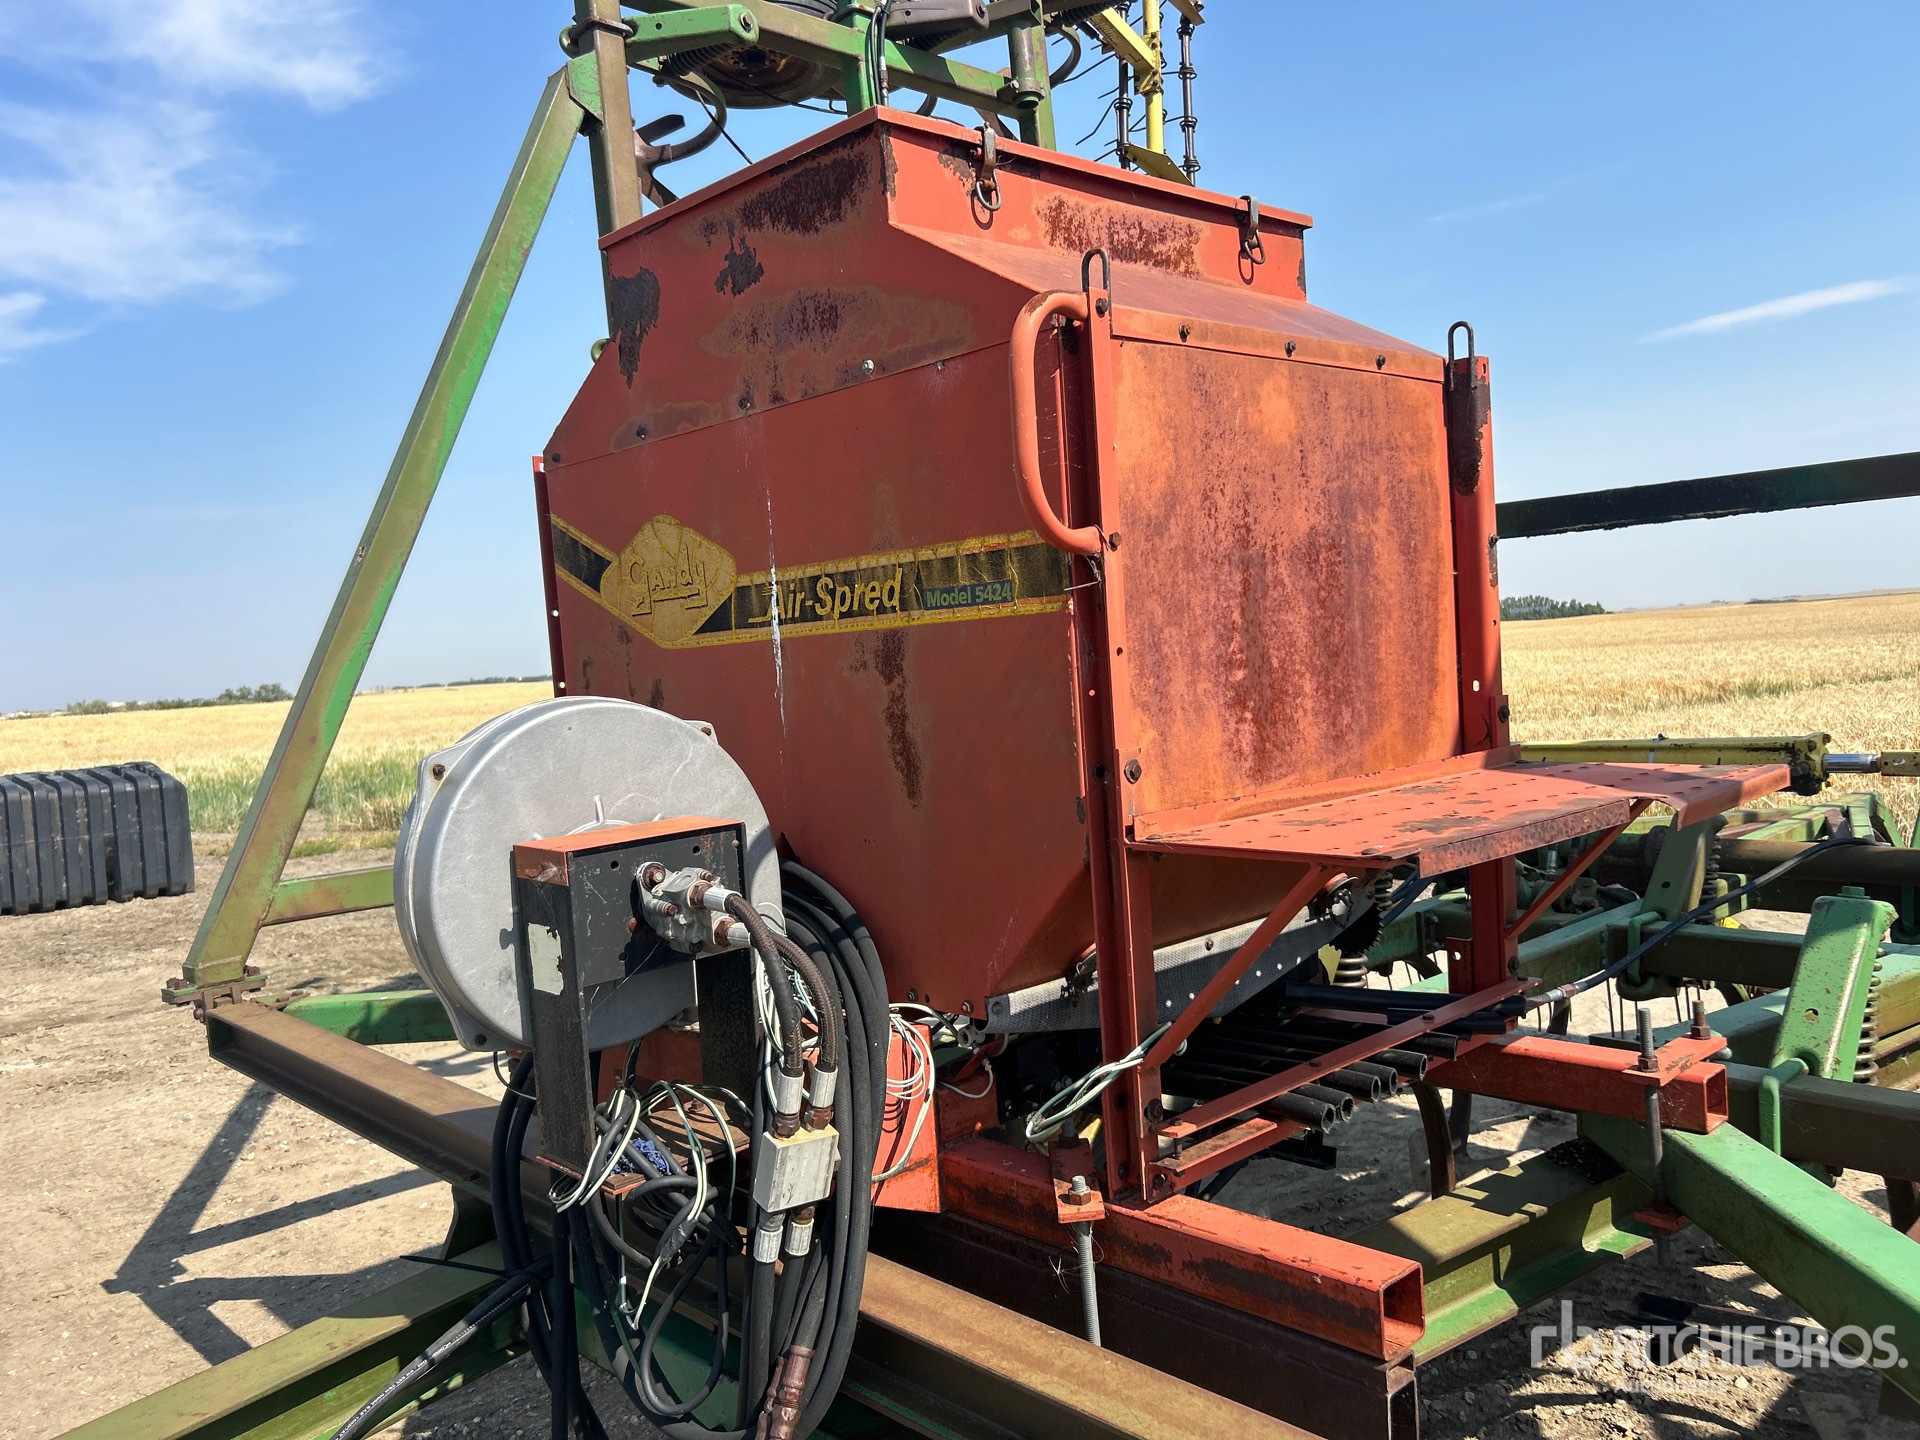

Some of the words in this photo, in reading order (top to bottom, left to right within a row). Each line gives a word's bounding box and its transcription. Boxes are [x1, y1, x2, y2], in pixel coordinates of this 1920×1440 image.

[748, 567, 903, 624] Air-Spred
[926, 585, 972, 607] Model
[975, 582, 1012, 604] 5424
